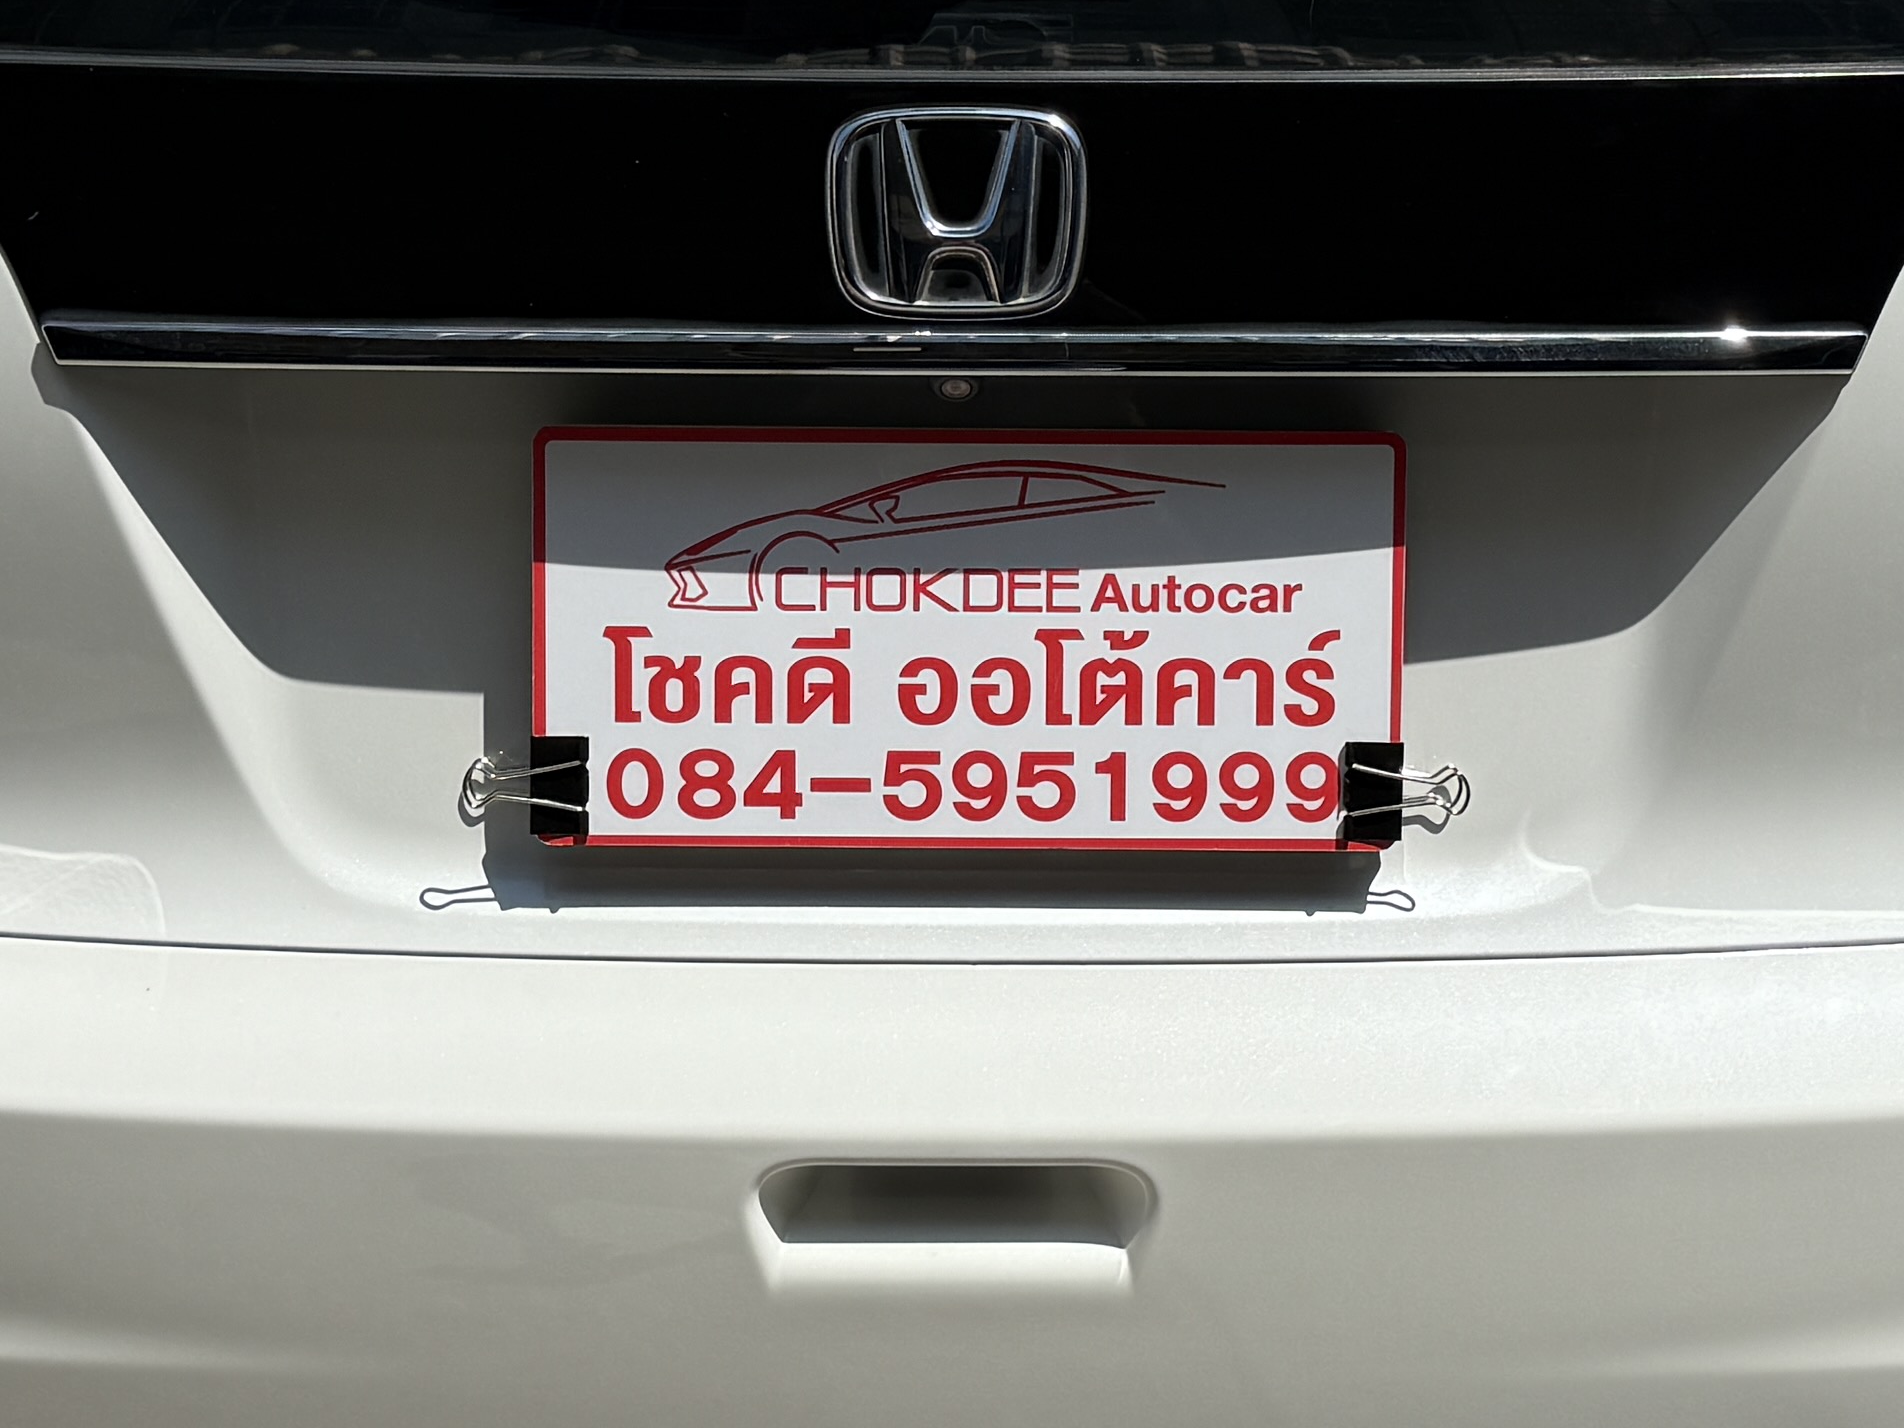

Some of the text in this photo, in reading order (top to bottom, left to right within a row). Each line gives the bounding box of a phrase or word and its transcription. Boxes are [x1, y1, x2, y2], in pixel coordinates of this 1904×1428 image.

[775, 566, 1304, 615] CHOKDEE Autocar
[602, 625, 1342, 728] โชคดี ออโต้คาร์
[605, 747, 1342, 823] 084-5951999
